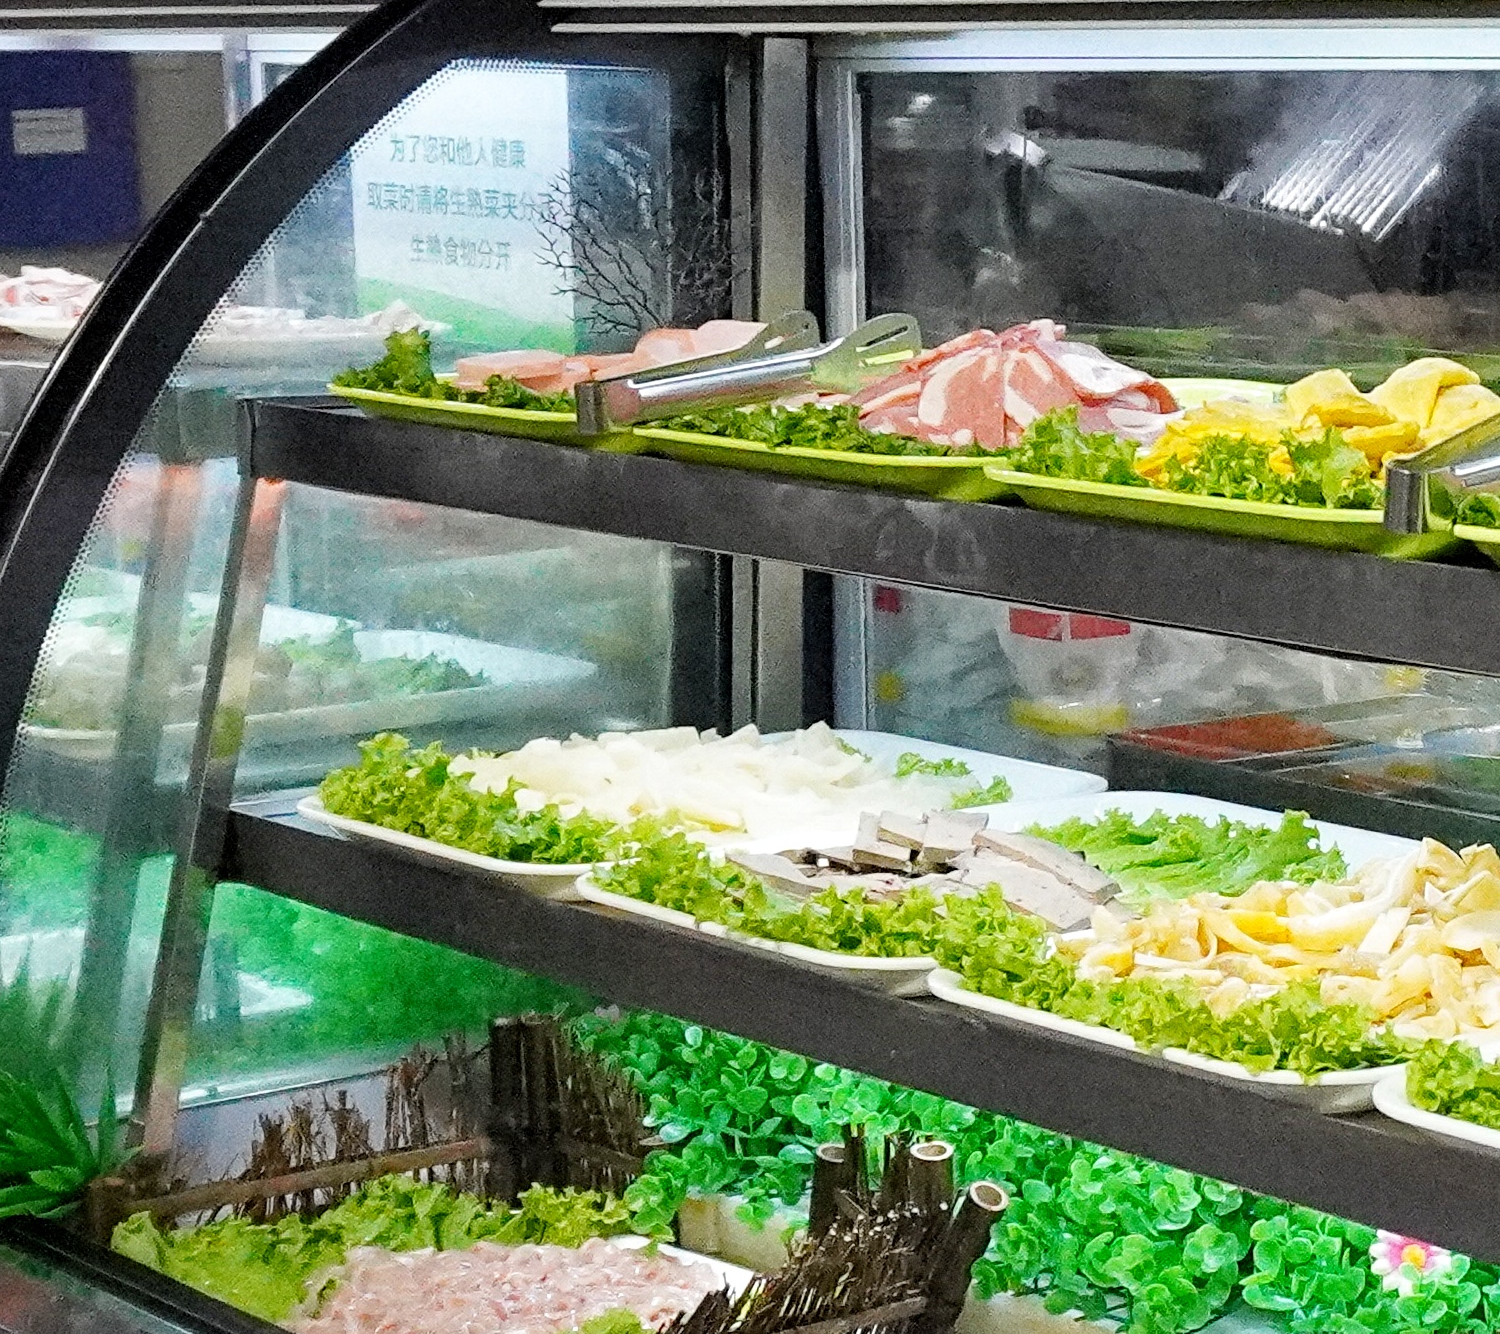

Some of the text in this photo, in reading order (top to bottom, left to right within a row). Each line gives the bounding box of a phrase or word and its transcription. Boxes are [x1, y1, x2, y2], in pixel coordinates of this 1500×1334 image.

[390, 133, 526, 167] 为了您和他人健康
[410, 234, 512, 271] 生熟食物分开
